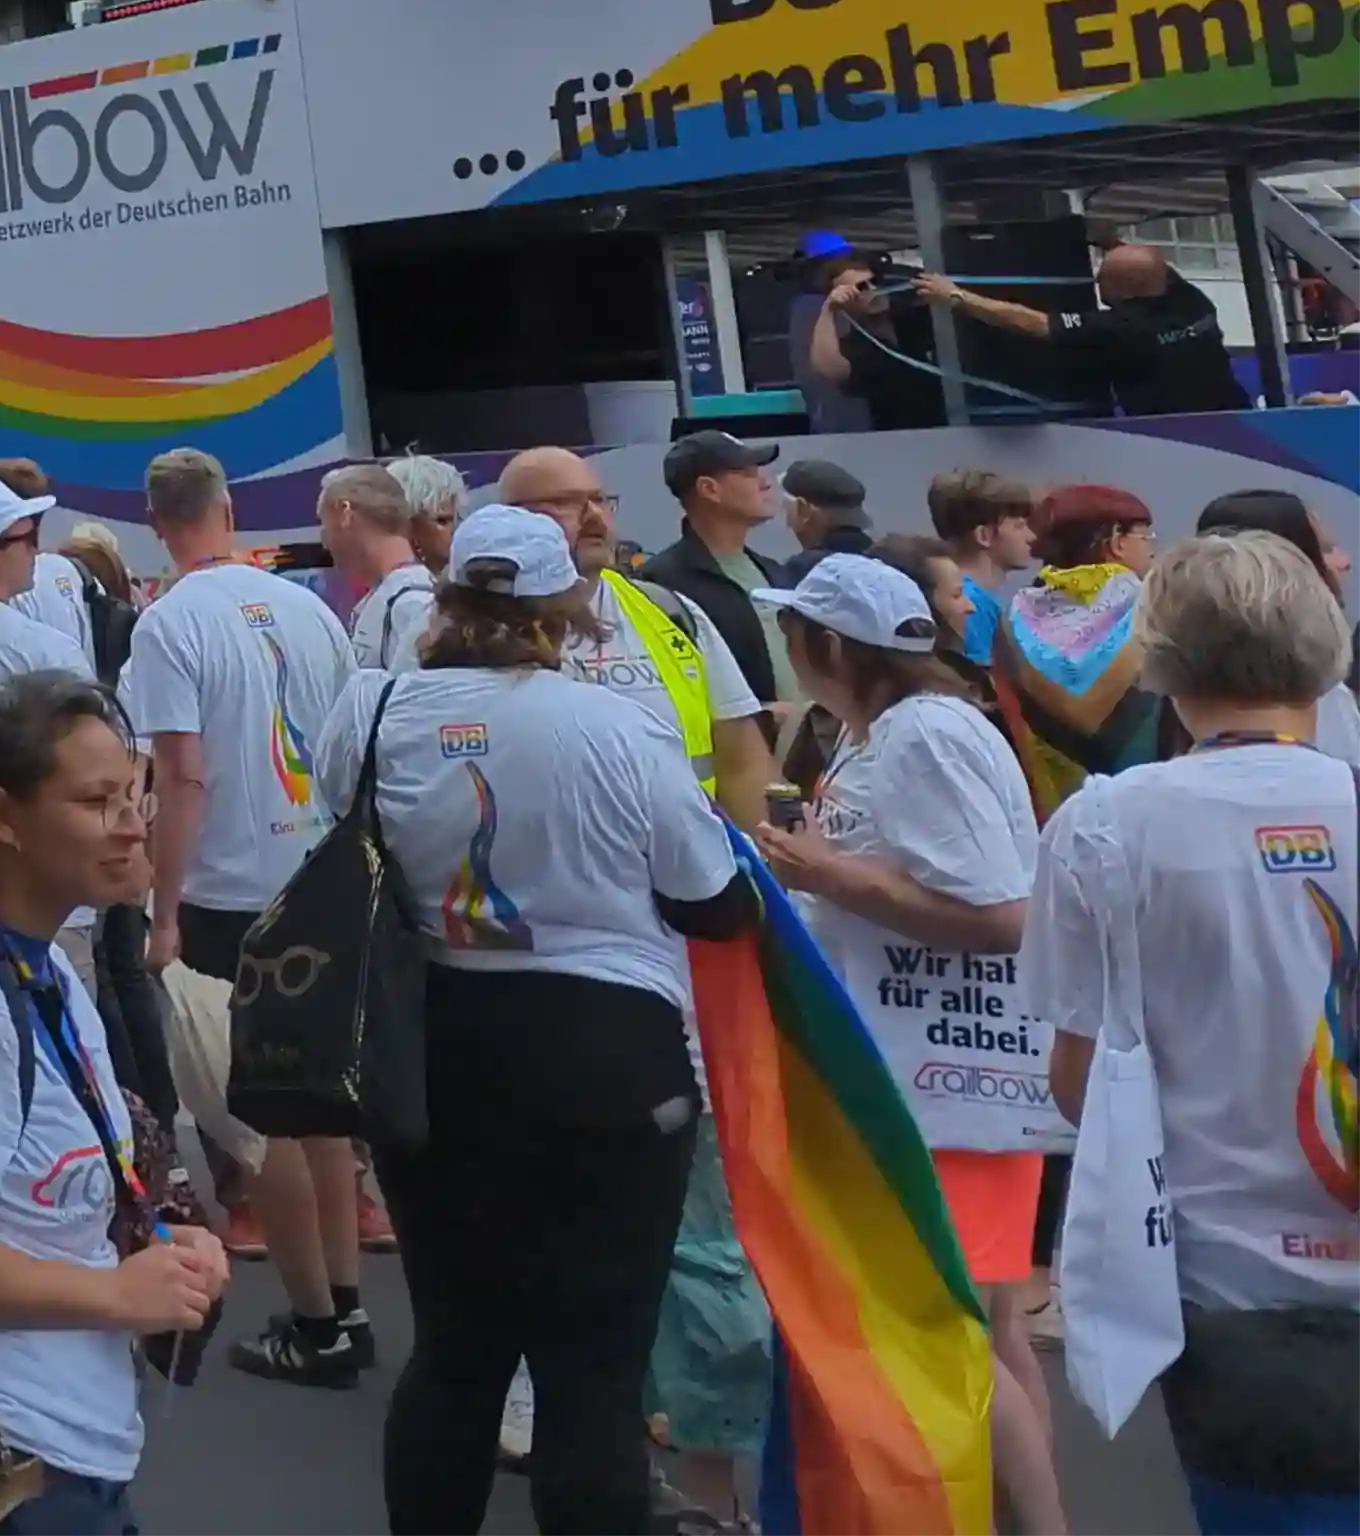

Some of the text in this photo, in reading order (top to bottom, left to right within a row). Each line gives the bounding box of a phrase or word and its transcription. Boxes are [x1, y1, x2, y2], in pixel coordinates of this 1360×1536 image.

[548, 66, 690, 163] für
[721, 22, 1011, 140] mehr
[80, 207, 112, 230] der
[118, 191, 229, 223] Deutschen
[235, 181, 292, 208] Bahn
[443, 727, 485, 754] DB
[1261, 830, 1330, 869] DB
[884, 944, 951, 978] Wir
[877, 976, 1005, 1018] für alle
[926, 1018, 1040, 1057] dabei.
